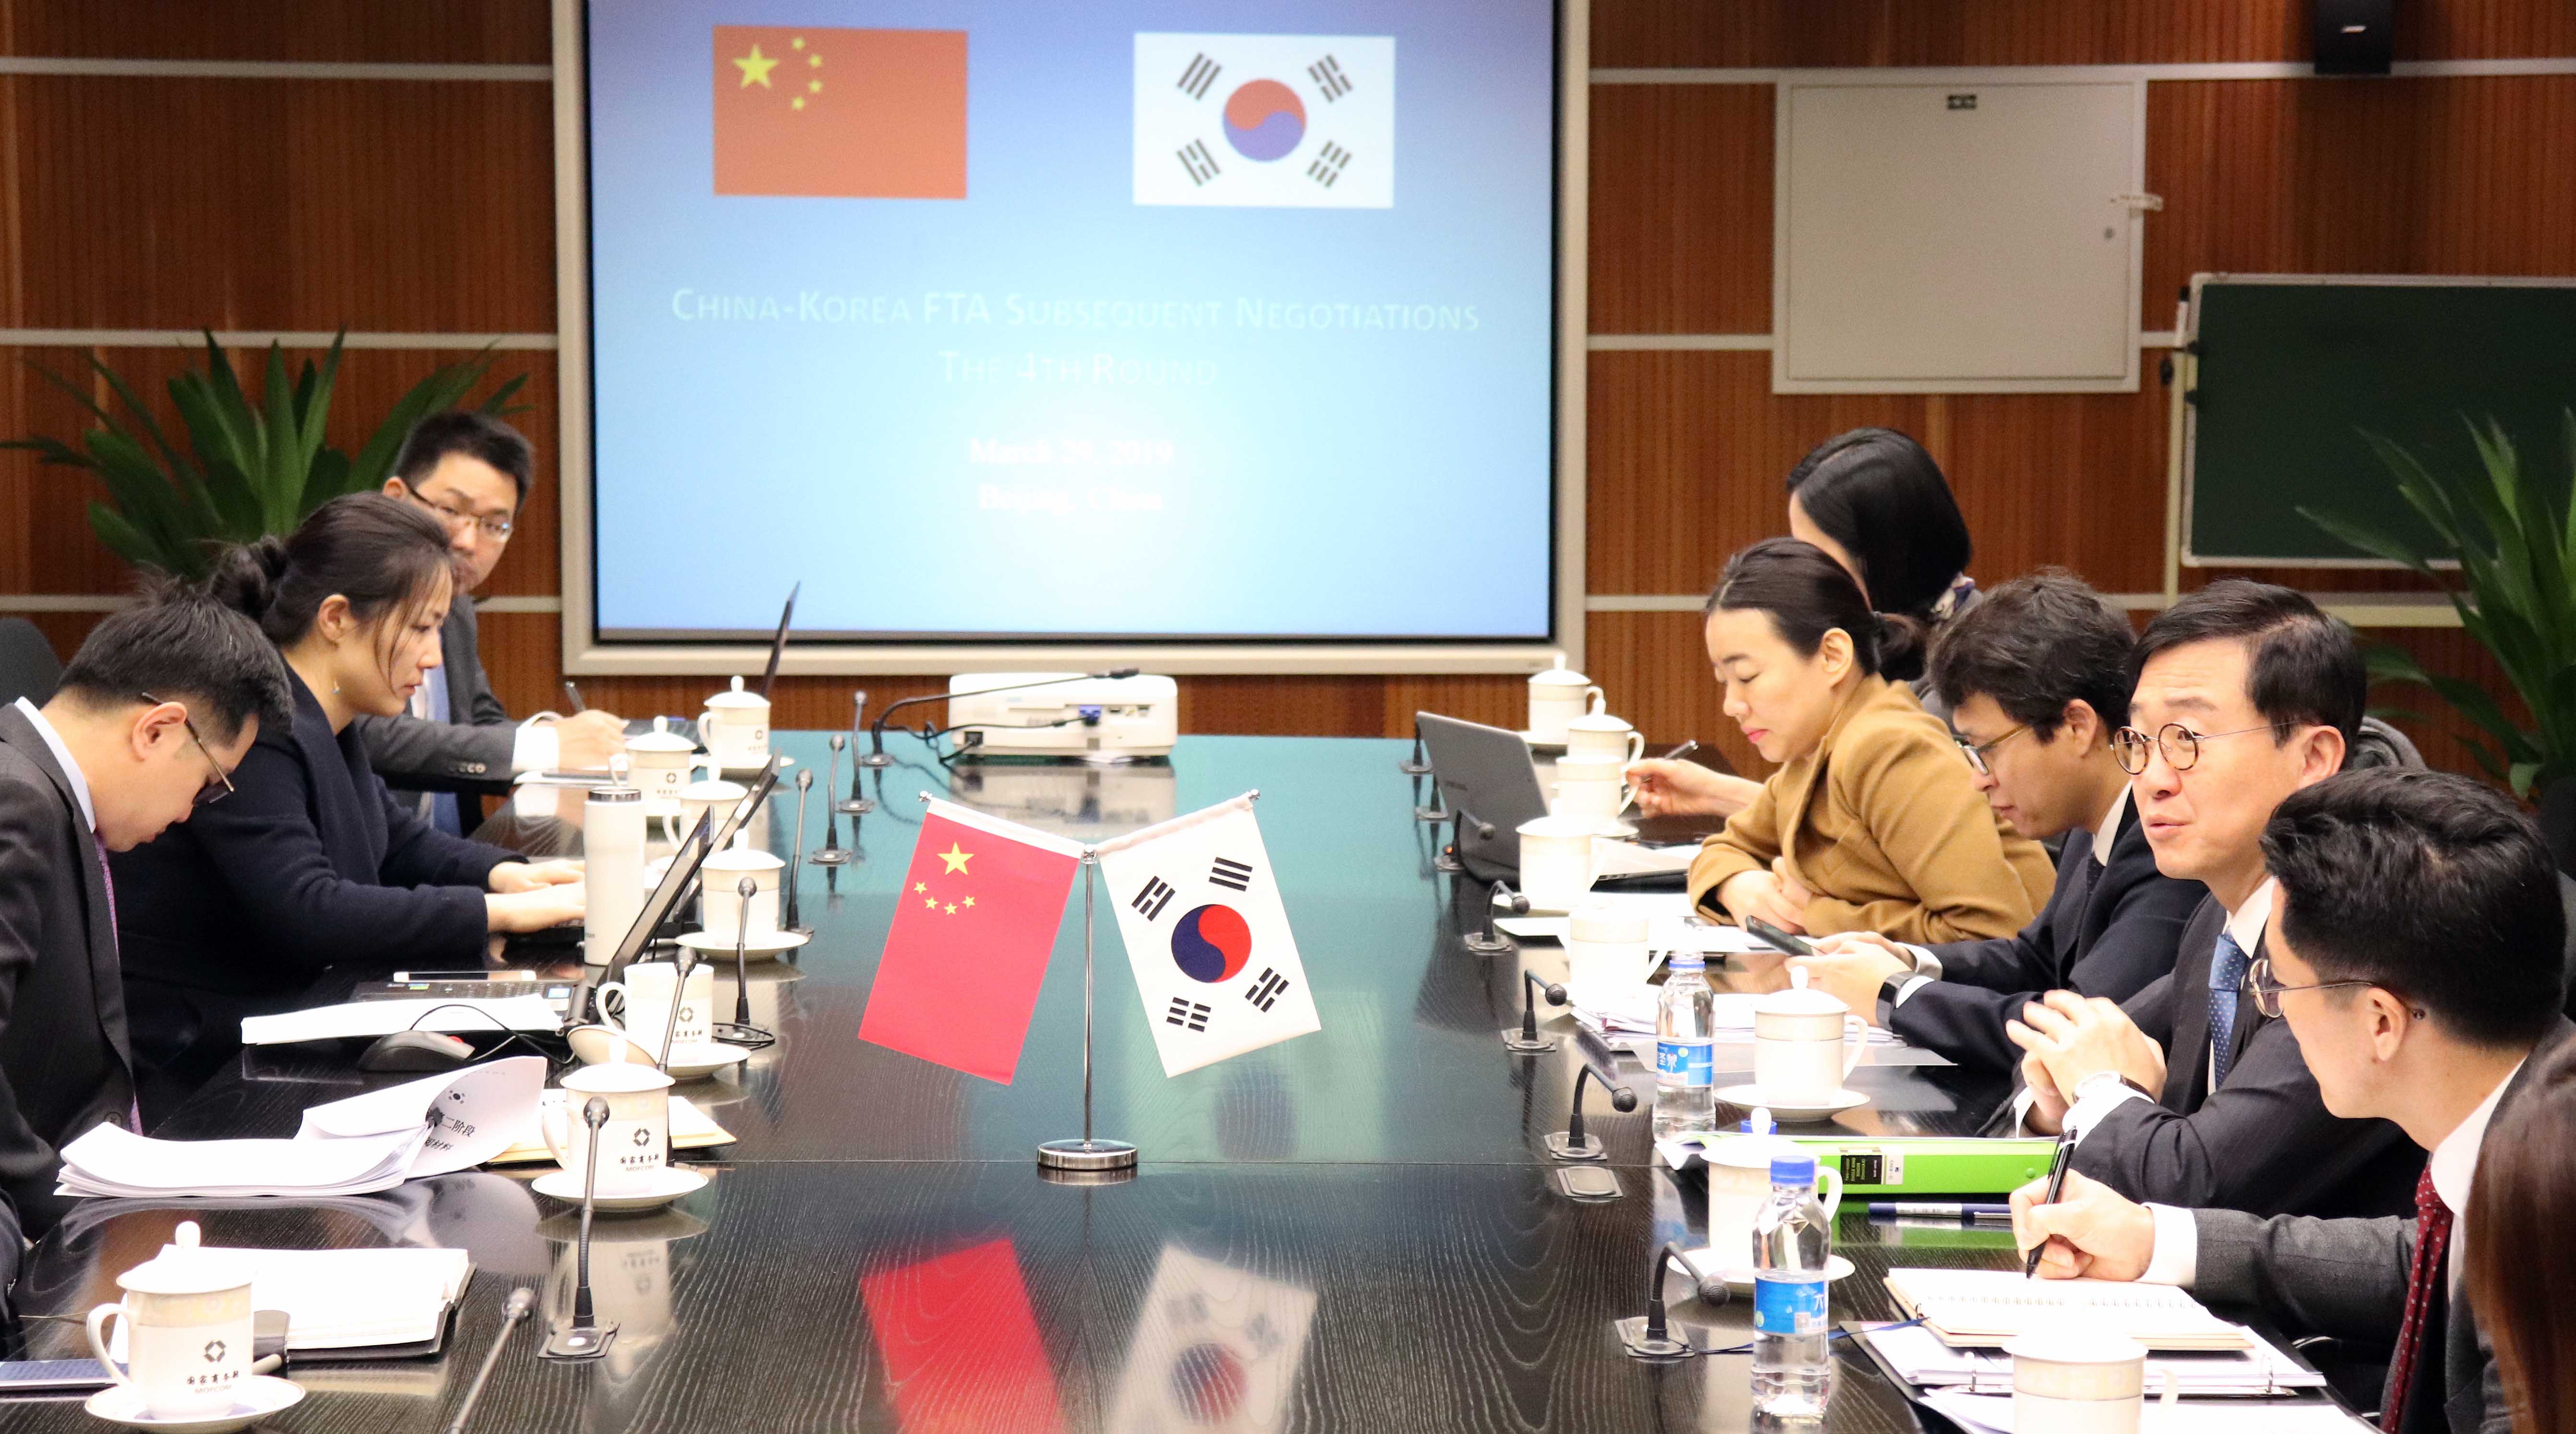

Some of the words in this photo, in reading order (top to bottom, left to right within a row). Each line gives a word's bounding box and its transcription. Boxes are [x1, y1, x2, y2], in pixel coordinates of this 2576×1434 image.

[924, 292, 991, 324] FTA
[1006, 292, 1222, 330] SUBSEQUENT
[1236, 296, 1480, 331] NEGOTIATIONS
[938, 350, 1000, 384] THE
[1092, 352, 1218, 385] ROUND
[441, 1112, 475, 1137] 二阶段
[194, 1385, 231, 1394] MOFCOM
